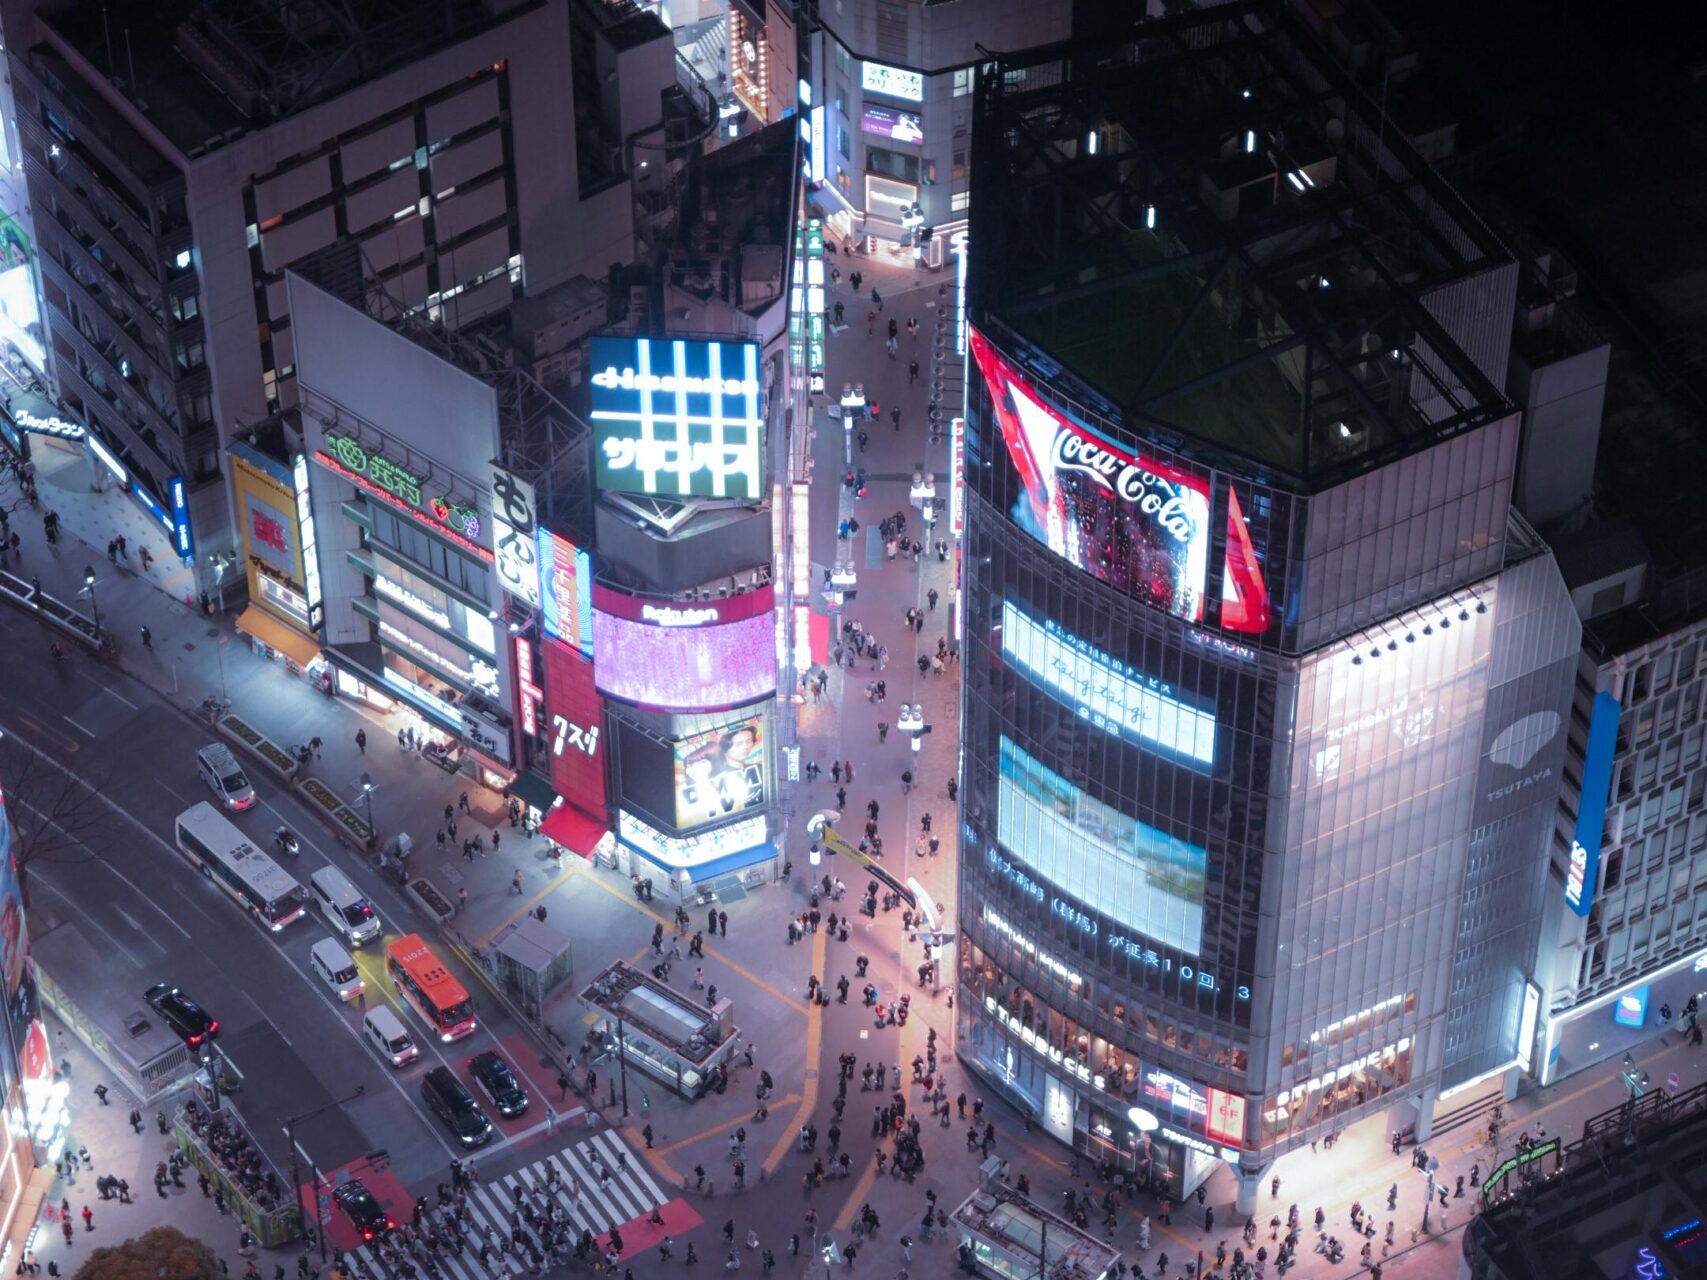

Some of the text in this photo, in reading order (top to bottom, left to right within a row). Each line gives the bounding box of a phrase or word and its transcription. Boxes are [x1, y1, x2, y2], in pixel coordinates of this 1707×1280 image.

[1051, 428, 1189, 542] Coca-Cola
[642, 604, 719, 627] Rakuten
[553, 714, 599, 757] クスリ
[1487, 767, 1553, 802] TSUTAYA
[985, 995, 1106, 1091] STARBUCKS
[1276, 1036, 1411, 1107] STARBUCKS
